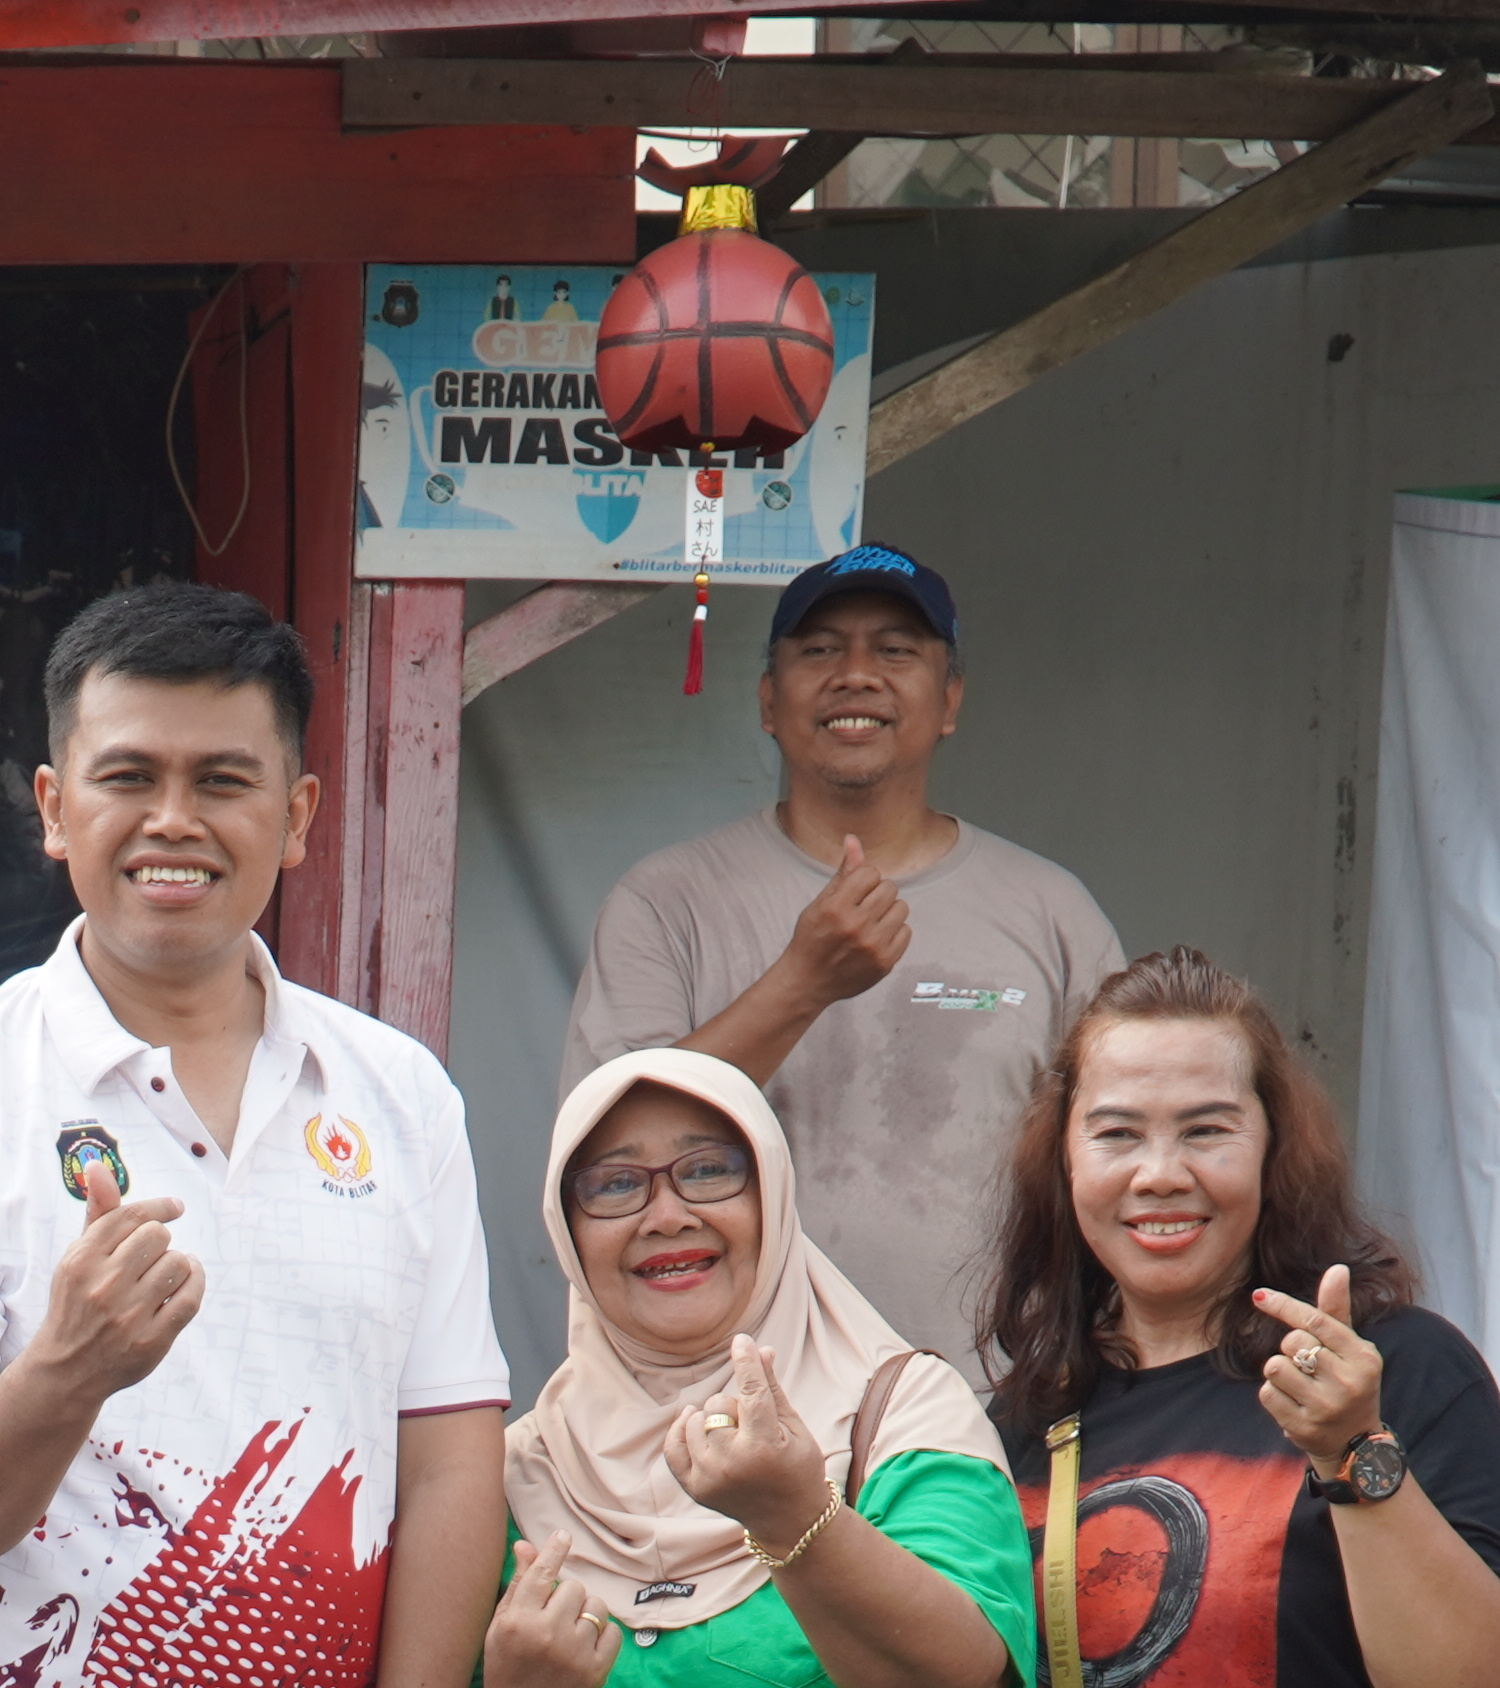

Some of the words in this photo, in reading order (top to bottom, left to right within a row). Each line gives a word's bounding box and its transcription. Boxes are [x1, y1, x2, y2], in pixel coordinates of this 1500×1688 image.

[475, 323, 602, 366] GEM
[619, 559, 808, 575] #blitarbermaskerblitar
[322, 1178, 345, 1198] KOTA
[348, 1179, 378, 1199] BLITAR
